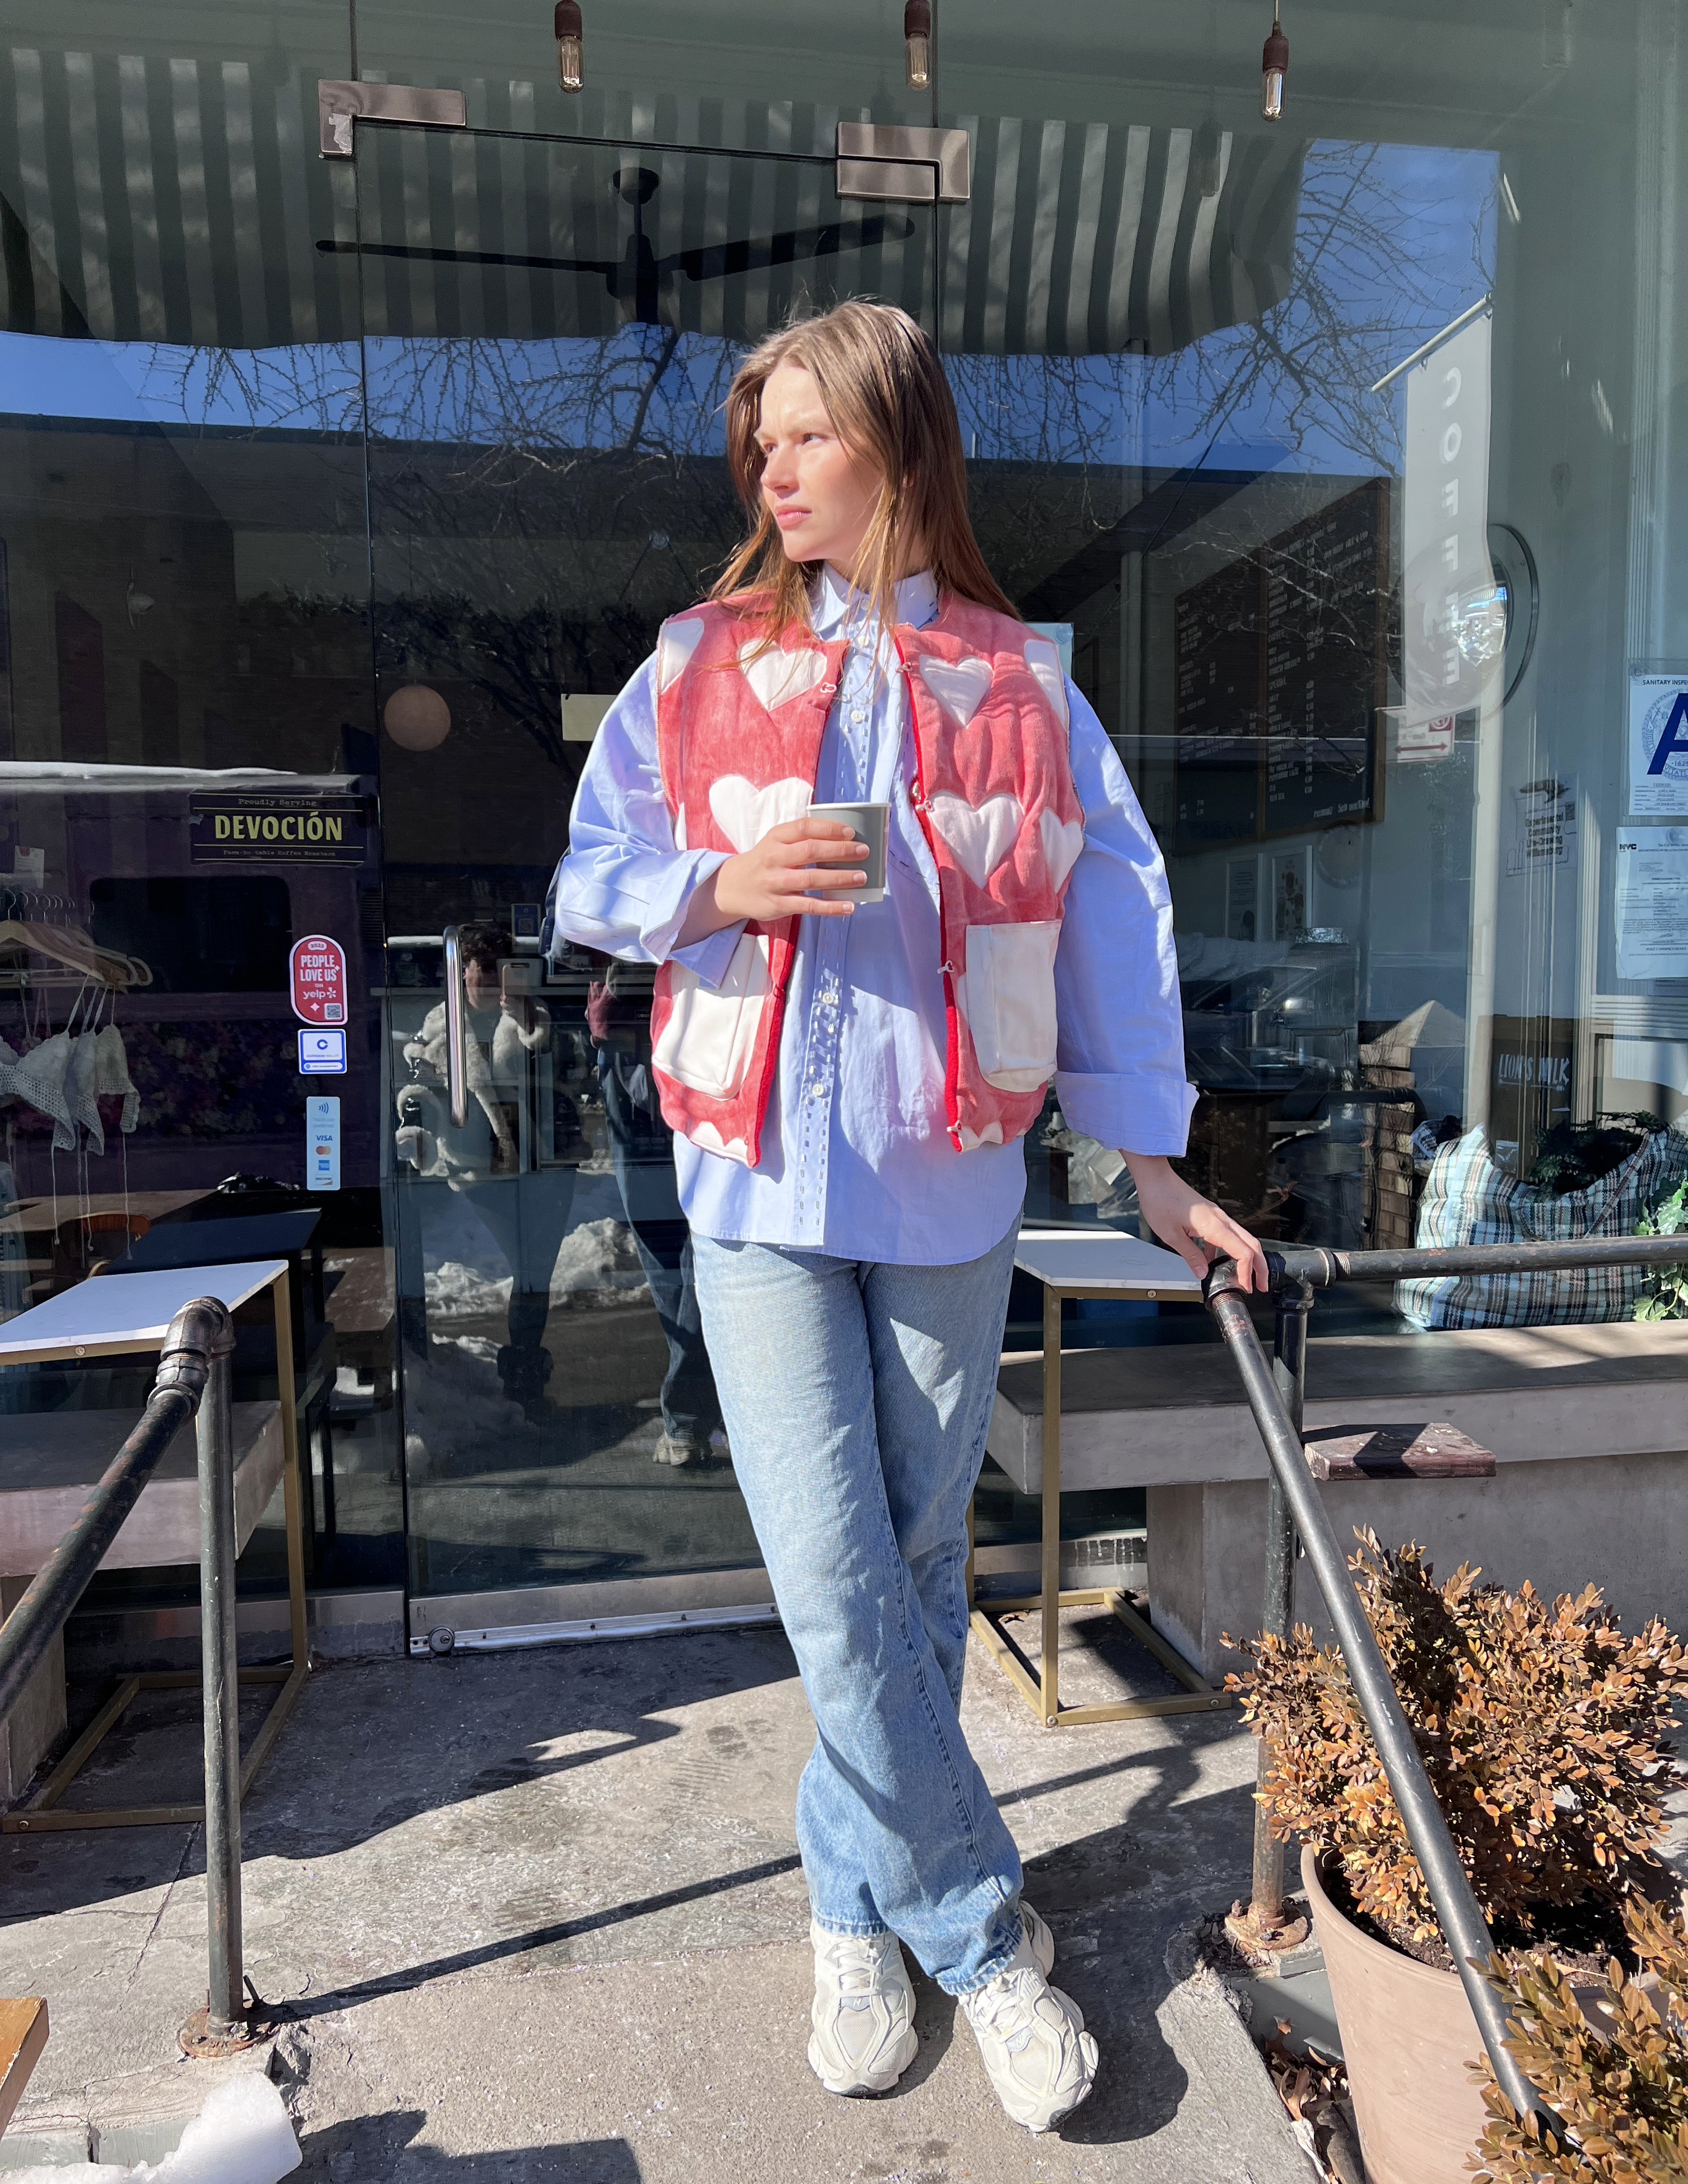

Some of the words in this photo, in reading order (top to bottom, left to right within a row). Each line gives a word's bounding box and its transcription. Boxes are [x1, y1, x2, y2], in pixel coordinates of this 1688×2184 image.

[215, 811, 342, 841] DEVOCIÓN
[301, 955, 335, 968] PEOPLE
[300, 969, 323, 981] LOVE
[325, 969, 337, 981] US
[303, 989, 326, 999] yelp
